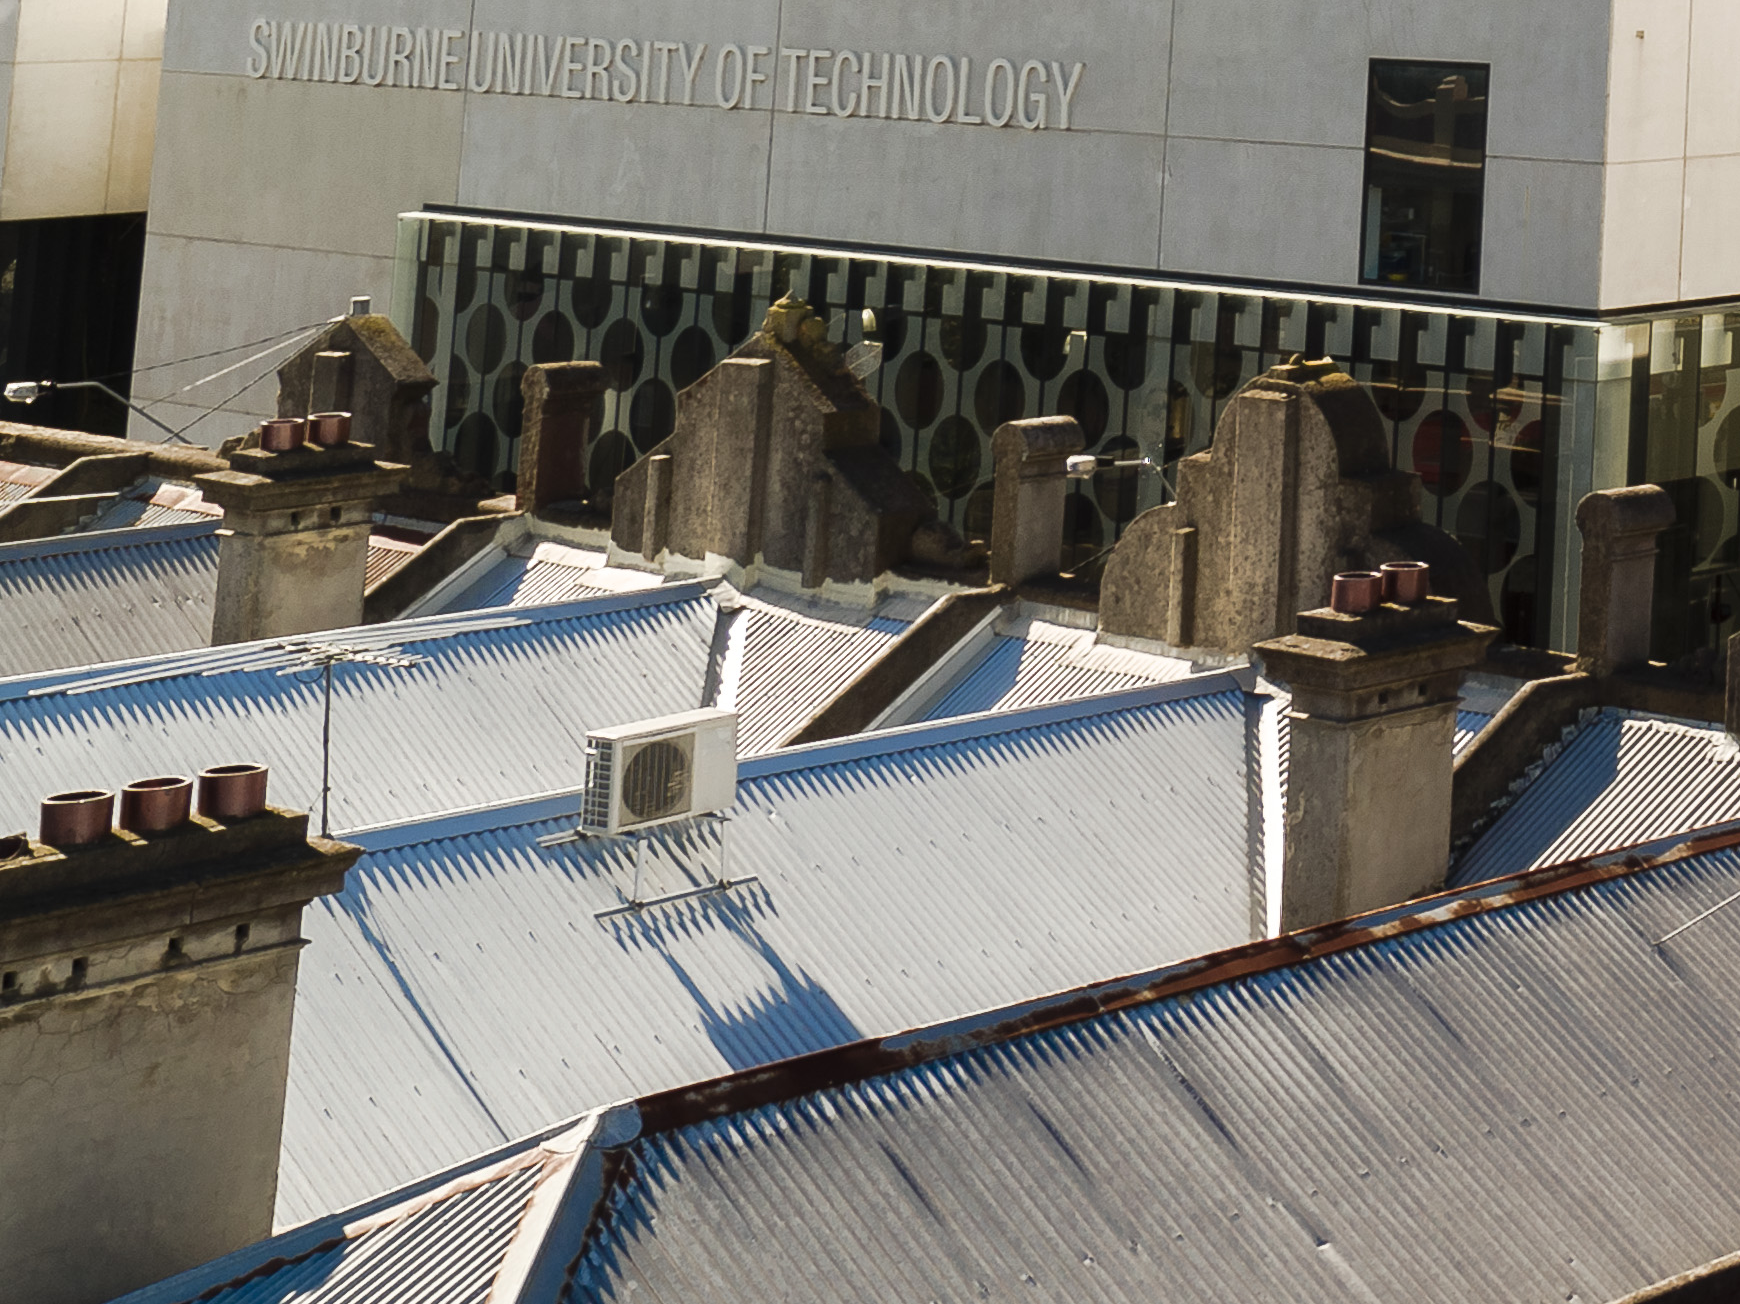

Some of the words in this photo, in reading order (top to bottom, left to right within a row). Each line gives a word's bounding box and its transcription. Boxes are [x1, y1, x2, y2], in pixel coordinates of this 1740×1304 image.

[246, 17, 464, 90] SWINBURNE
[471, 30, 708, 106] UNIVERSITY
[716, 42, 769, 110] OF
[780, 46, 1085, 130] TECHNOLOGY
